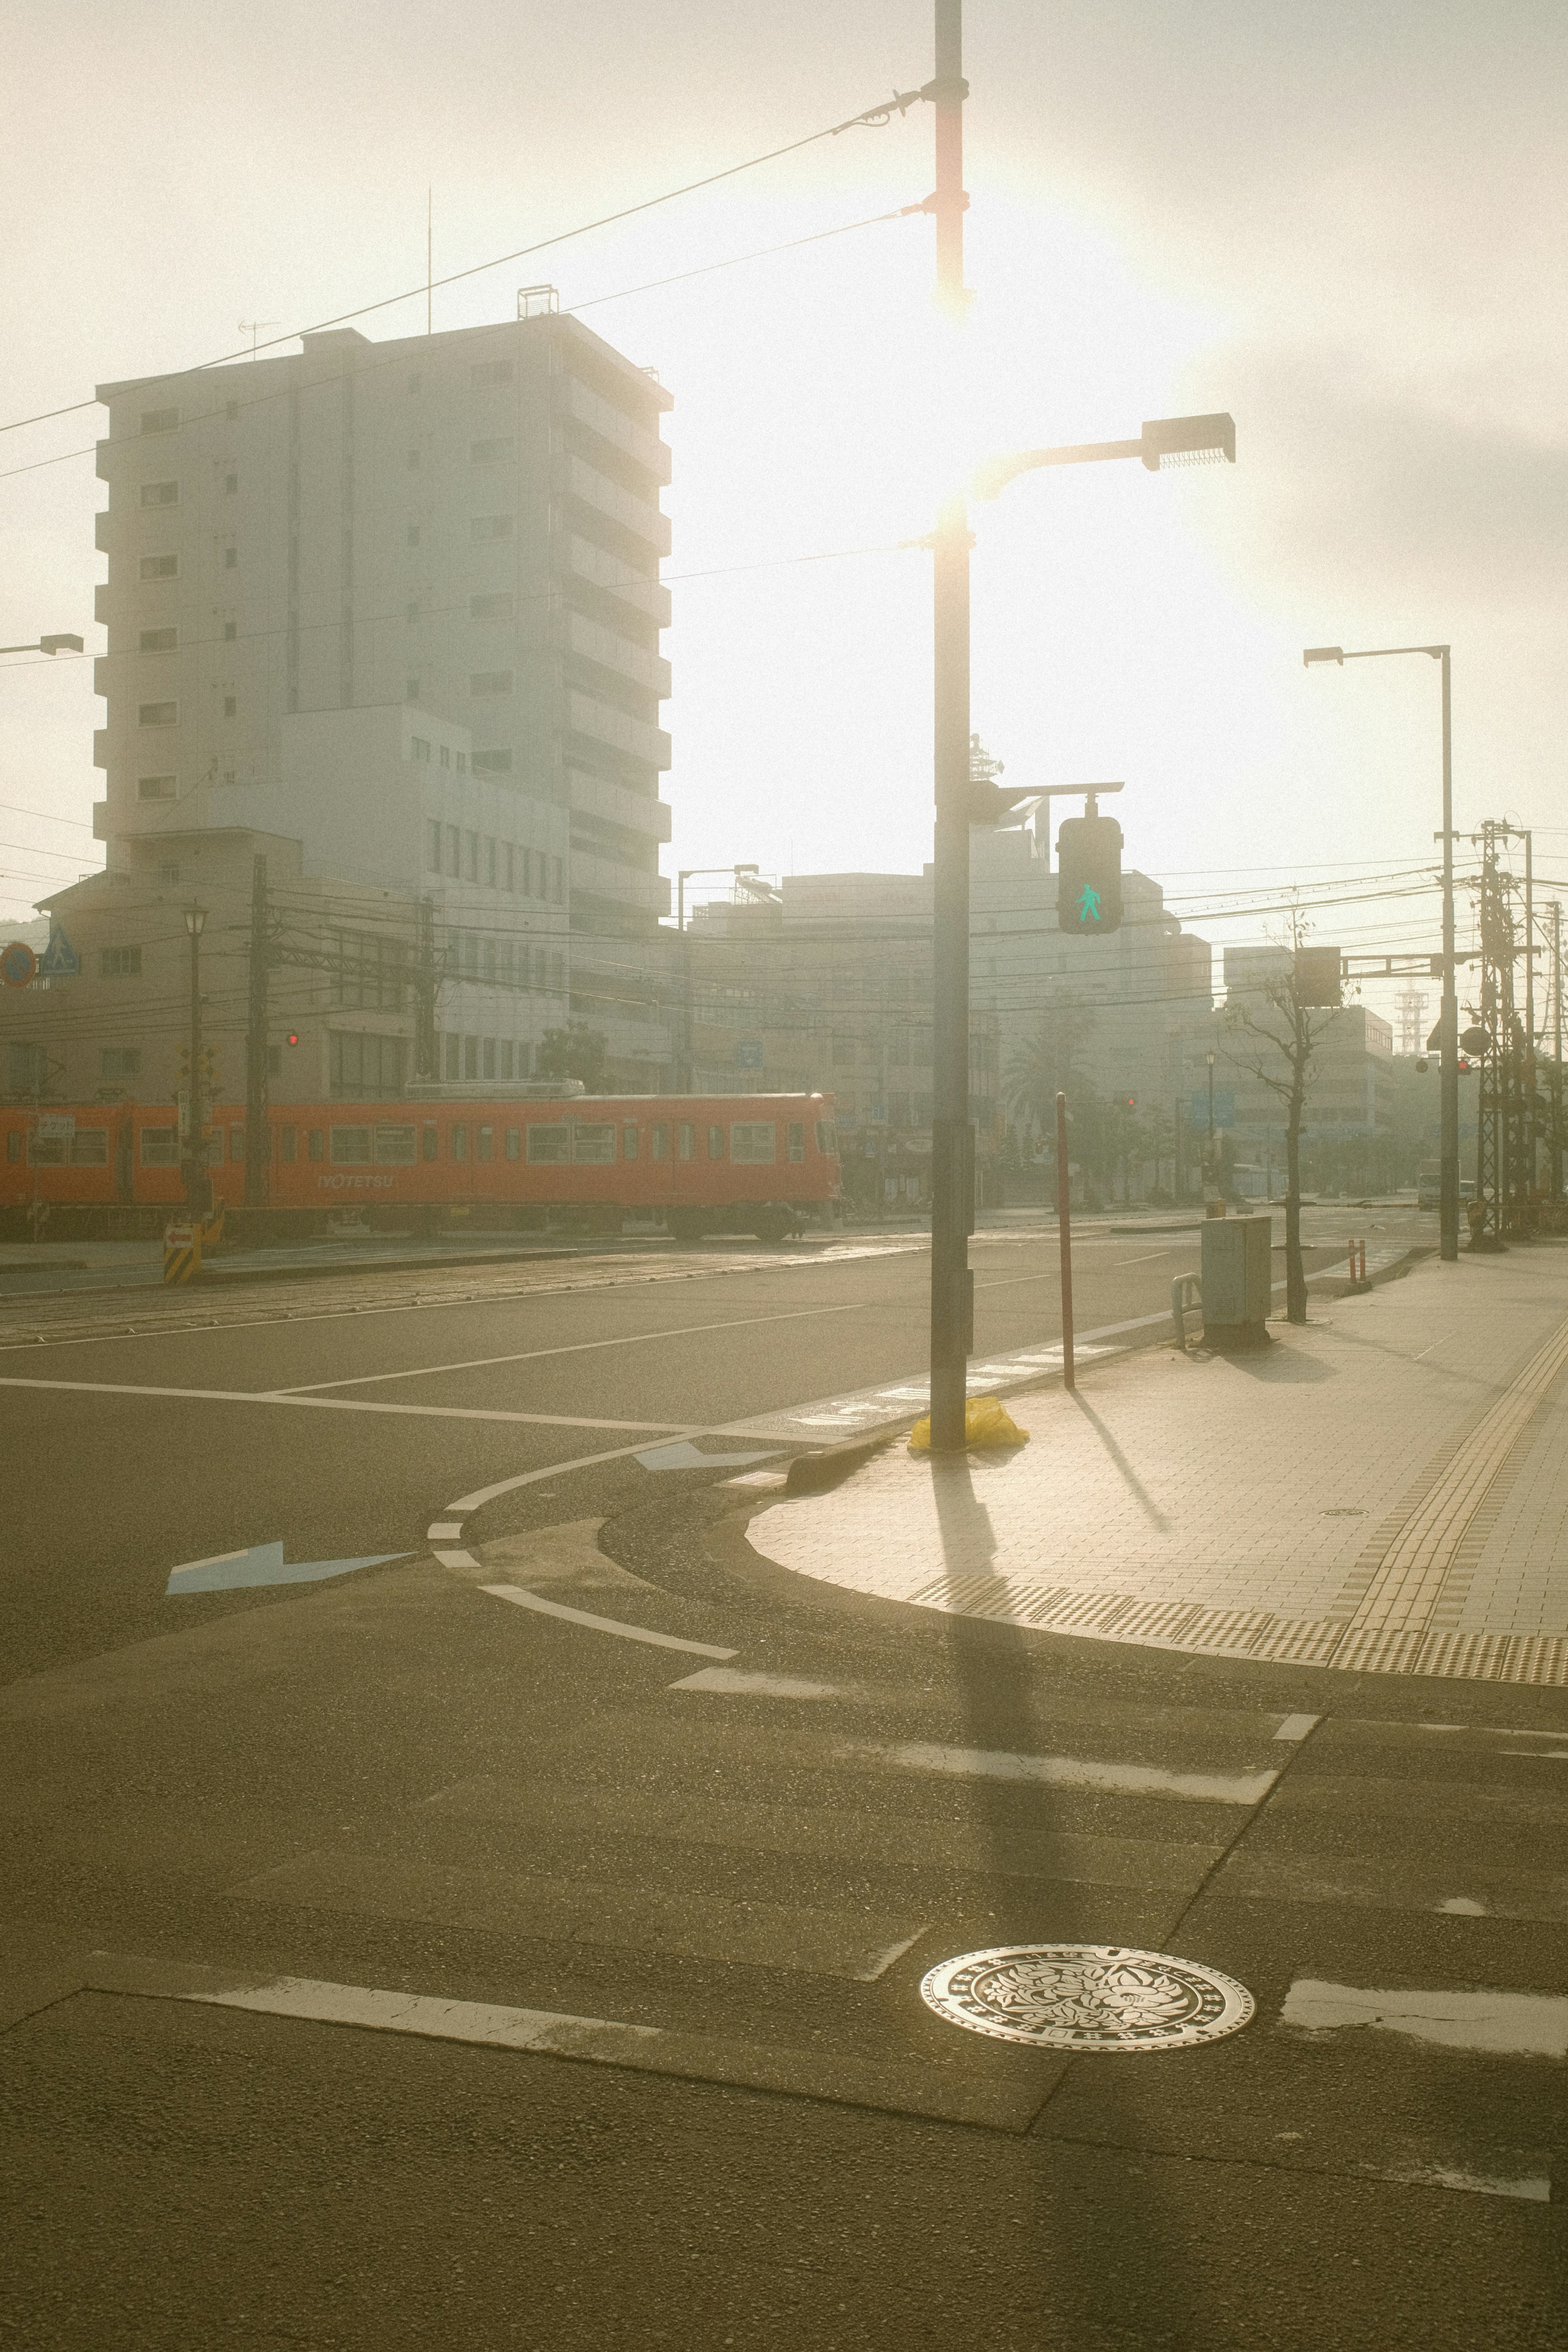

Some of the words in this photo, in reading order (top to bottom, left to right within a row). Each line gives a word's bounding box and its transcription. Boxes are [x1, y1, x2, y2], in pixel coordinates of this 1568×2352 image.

[318, 1174, 394, 1189] IYOTETSU
[1139, 1961, 1202, 1982] まつやま
